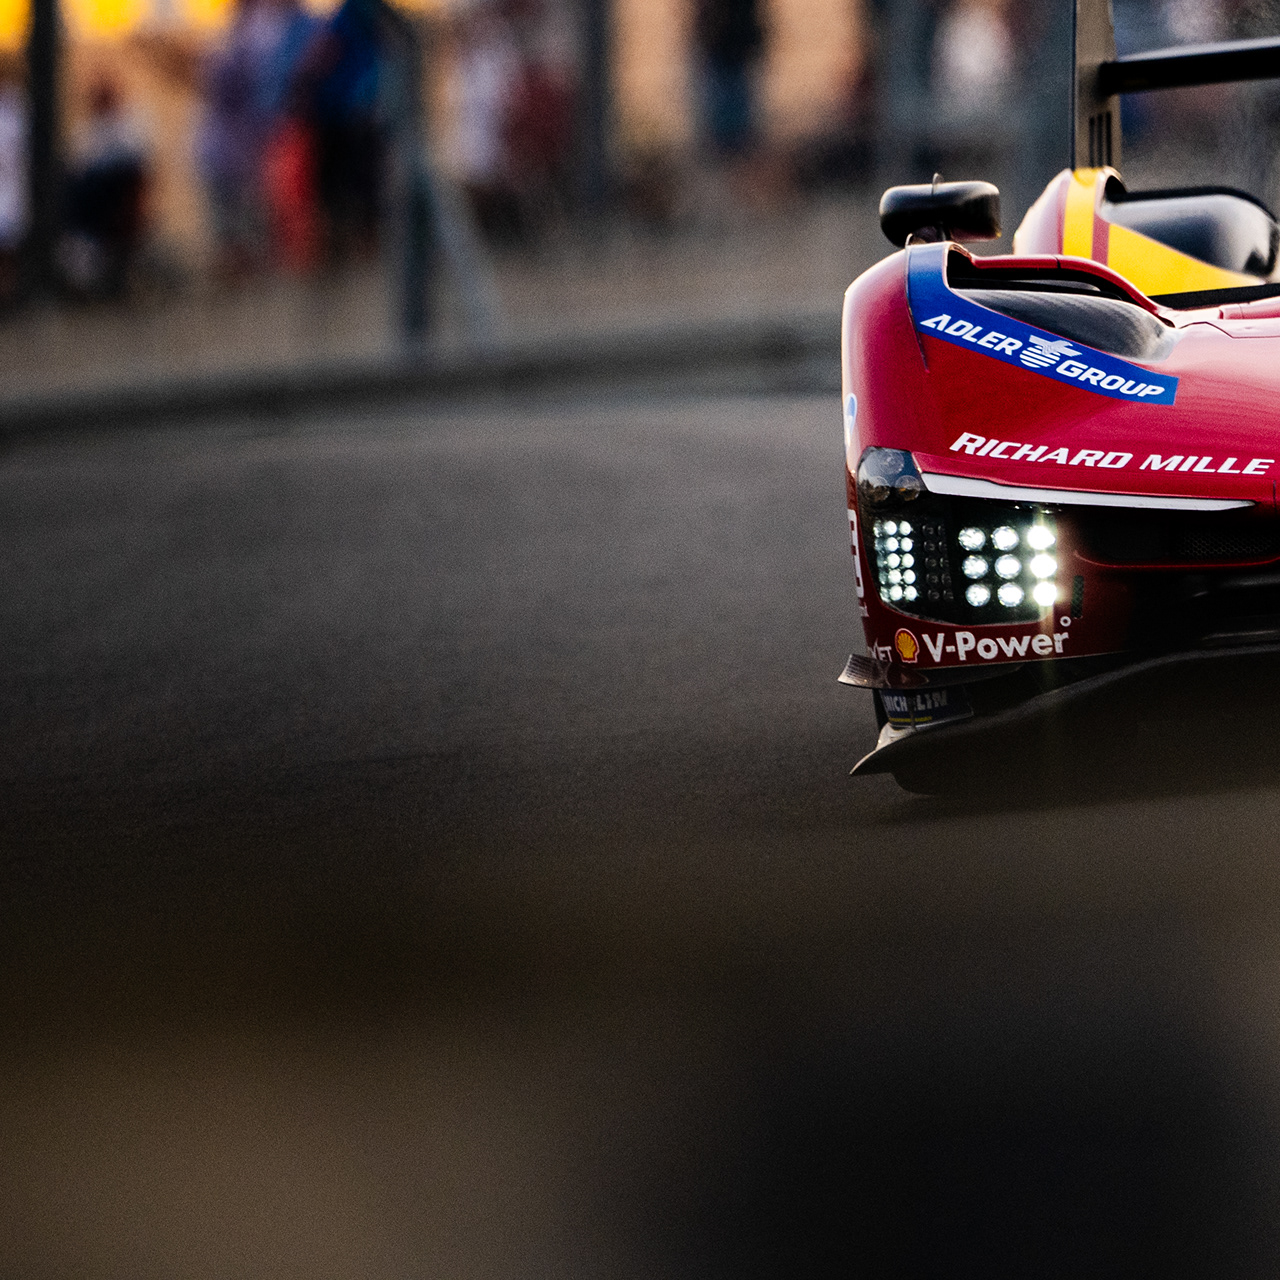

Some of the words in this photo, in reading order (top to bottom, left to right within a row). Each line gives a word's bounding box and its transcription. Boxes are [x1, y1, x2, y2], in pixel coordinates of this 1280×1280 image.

[920, 313, 1024, 356] ADLER
[1056, 359, 1166, 398] GROUP
[949, 432, 1133, 469] RICHARD
[1139, 454, 1276, 475] MILLE
[922, 631, 1069, 663] V-Power
